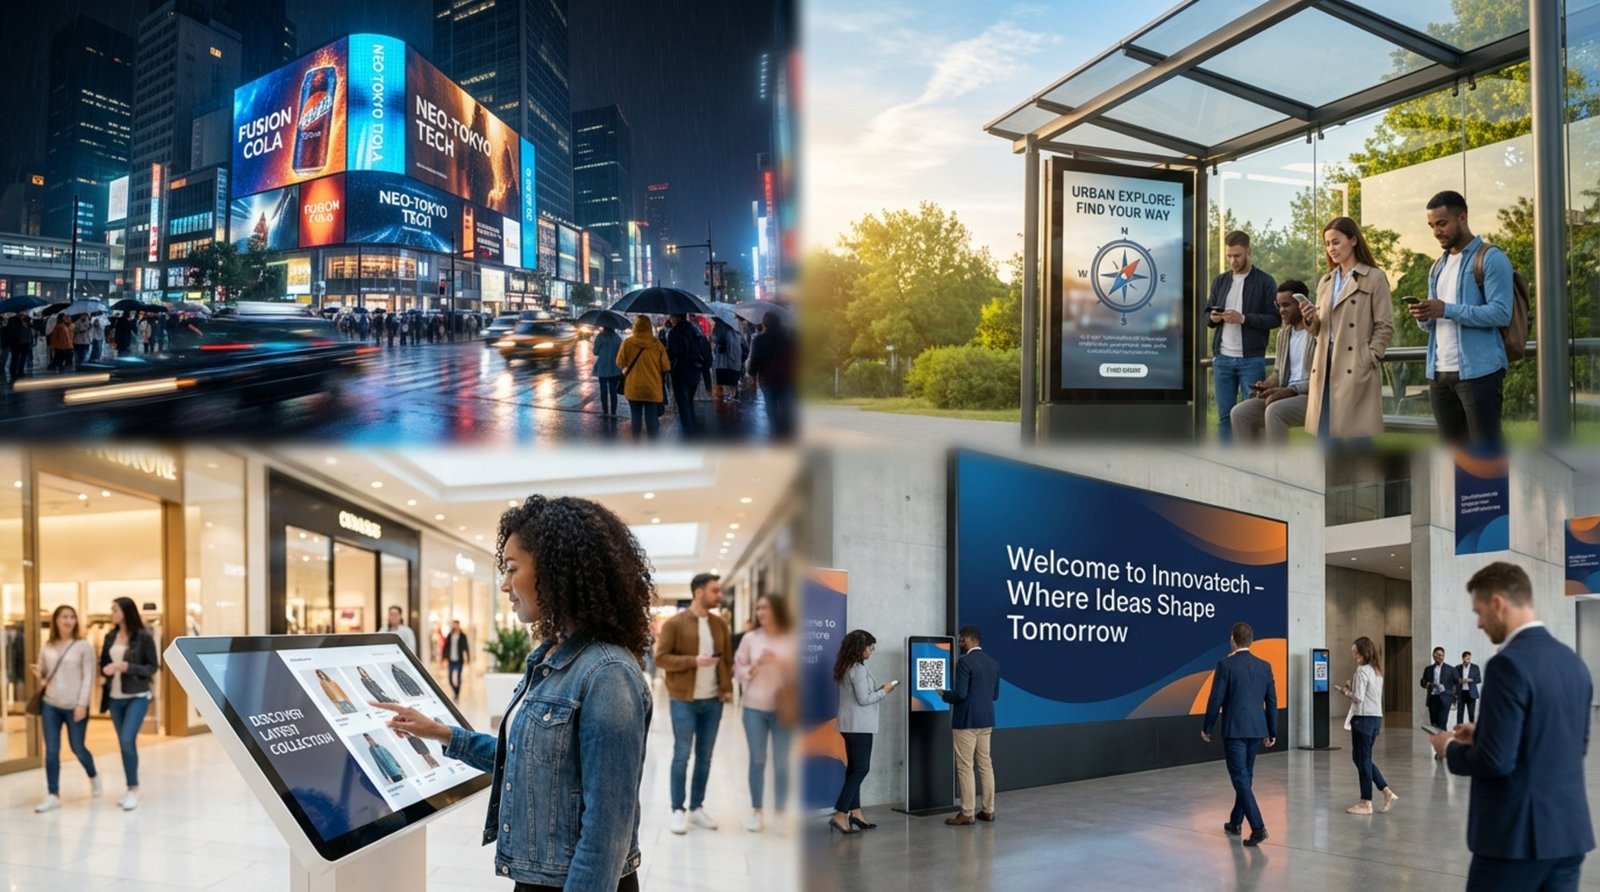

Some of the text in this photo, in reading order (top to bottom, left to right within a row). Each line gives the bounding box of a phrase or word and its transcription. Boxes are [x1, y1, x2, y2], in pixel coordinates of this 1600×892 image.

[238, 106, 292, 143] FUSION
[416, 94, 492, 157] NEO-TOKYO
[416, 119, 454, 158] TECH
[243, 131, 283, 159] COLA
[379, 190, 448, 219] NEO-TOKYO
[1072, 185, 1175, 207] URBAN EXPLORE:
[1076, 201, 1170, 221] FIND YOUR WAY
[1121, 227, 1128, 235] N
[1120, 317, 1127, 325] S
[1006, 544, 1120, 581] Welcome
[1125, 561, 1146, 583] to
[1152, 564, 1250, 595] Innovatech
[1006, 580, 1215, 623] Where Ideas Shape
[1006, 614, 1128, 643] Tomorrow
